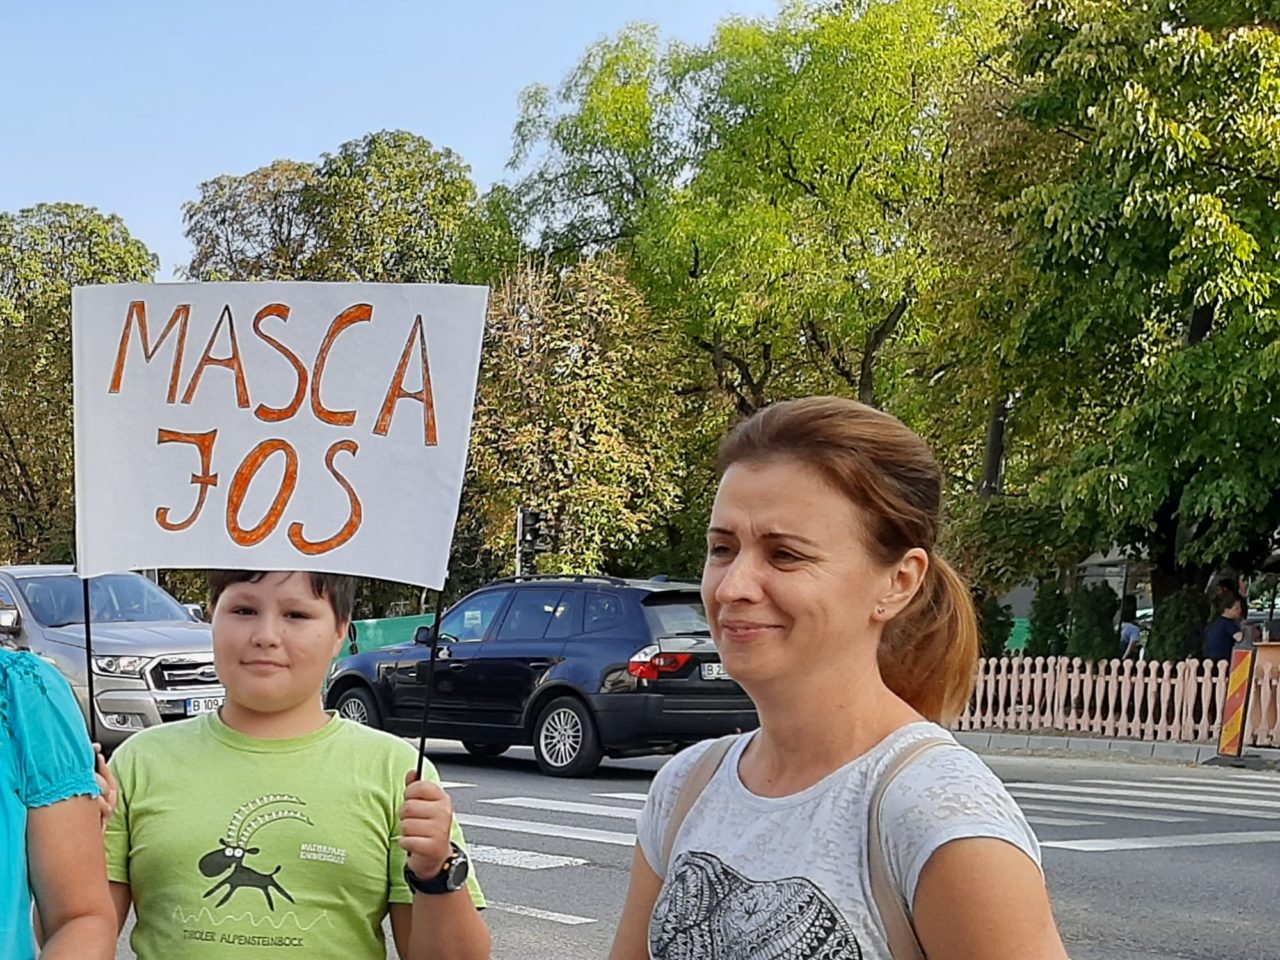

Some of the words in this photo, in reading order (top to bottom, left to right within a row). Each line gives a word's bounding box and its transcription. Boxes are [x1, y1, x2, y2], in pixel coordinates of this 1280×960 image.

[109, 300, 438, 446] MASCA
[155, 427, 362, 556] JOS
[707, 664, 714, 676] B
[193, 700, 200, 711] B
[183, 929, 216, 942] TIROLER
[219, 933, 304, 947] ALPENSTEINBOCK
